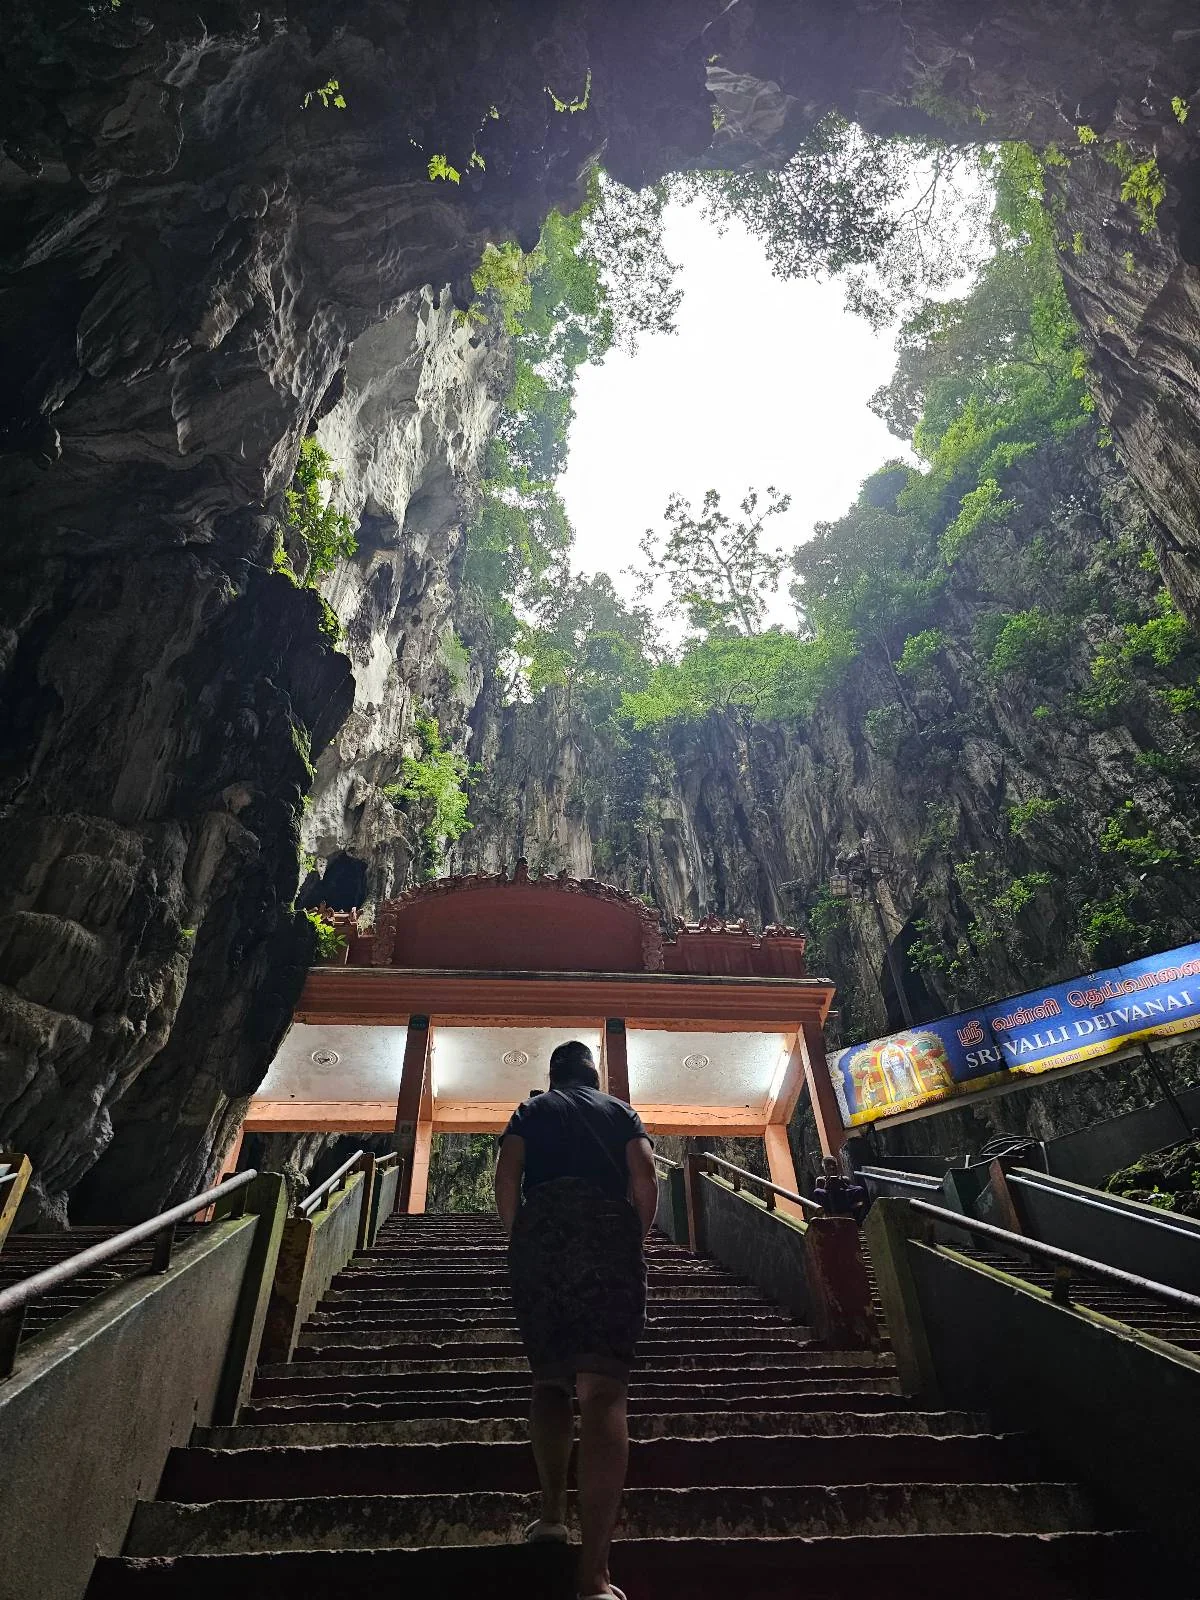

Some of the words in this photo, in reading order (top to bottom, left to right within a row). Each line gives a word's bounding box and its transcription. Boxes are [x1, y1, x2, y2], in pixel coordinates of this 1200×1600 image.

[965, 1046, 1002, 1068] SRI
[1003, 1025, 1071, 1056] VALLI
[1072, 991, 1195, 1037] DEIVANAI
[992, 998, 1062, 1032] வள்ளி
